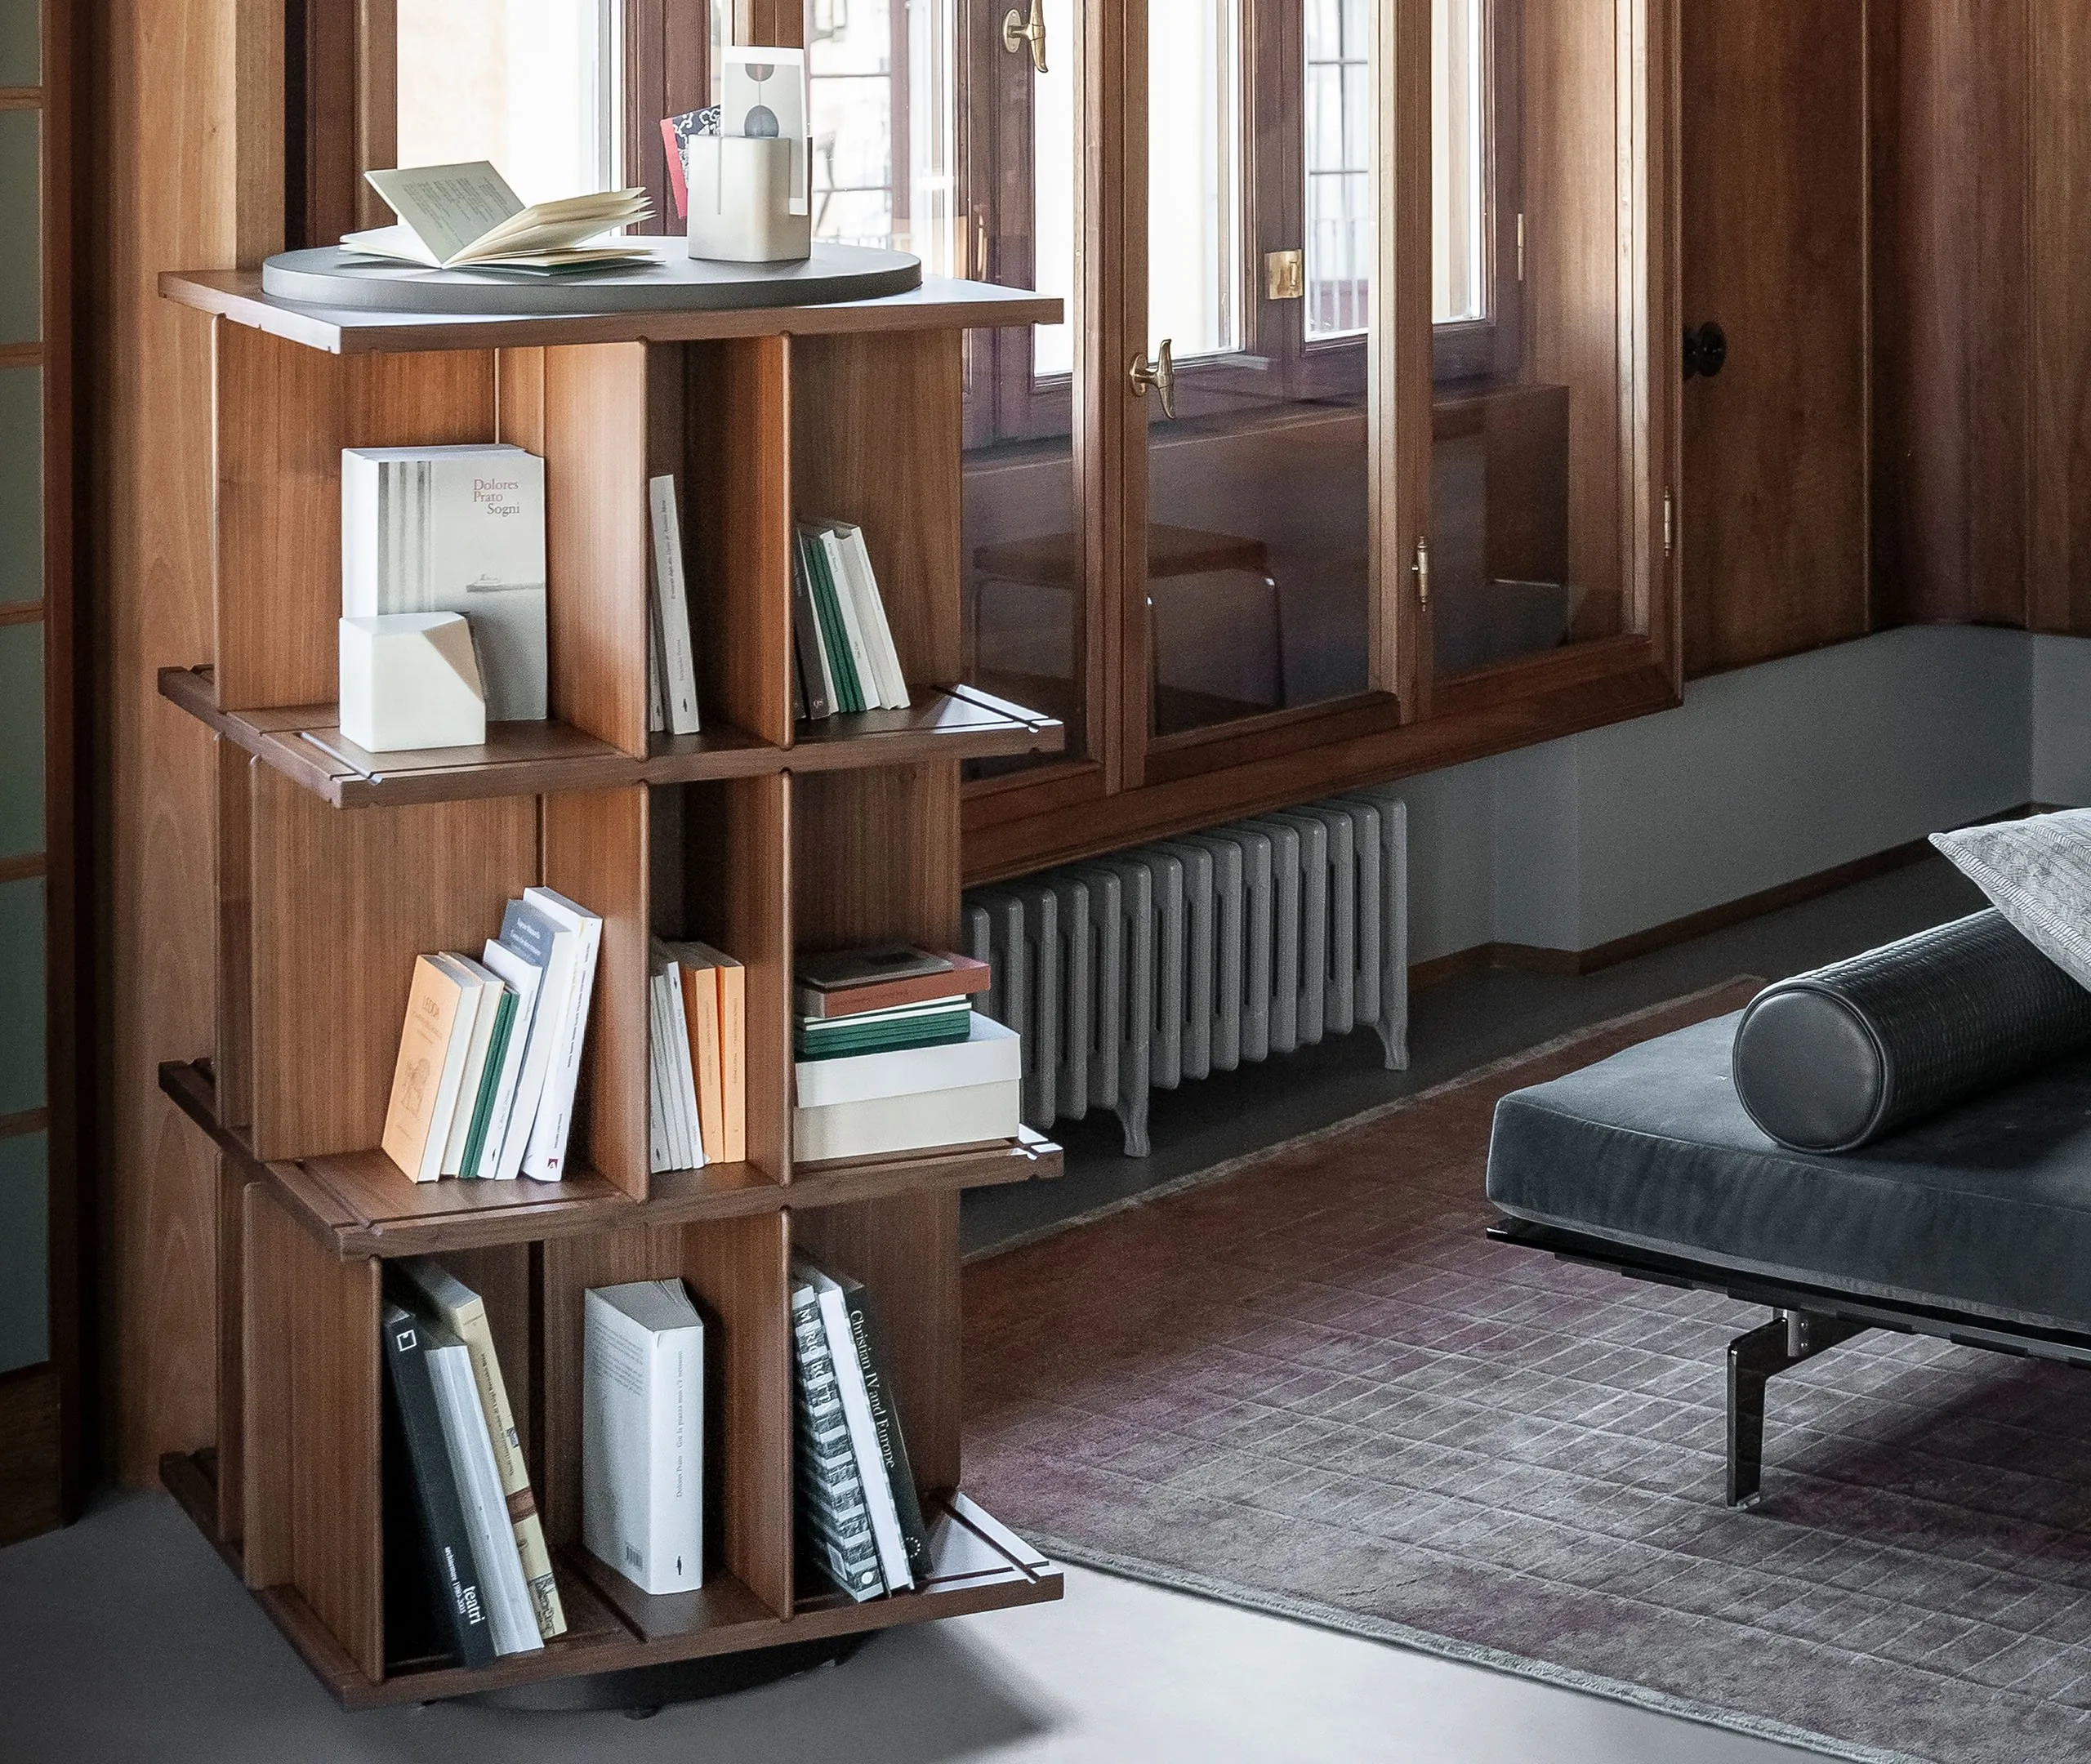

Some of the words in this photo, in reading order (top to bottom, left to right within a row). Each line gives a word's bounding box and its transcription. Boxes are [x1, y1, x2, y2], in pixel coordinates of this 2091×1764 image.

[474, 479, 519, 490] Dolores
[474, 491, 503, 502] Prato
[487, 501, 520, 517] Sogni
[850, 1309, 872, 1370] Christian
[865, 1371, 880, 1388] IV
[869, 1390, 886, 1416] and
[876, 1418, 895, 1468] Europe
[462, 1586, 486, 1624] teatri
